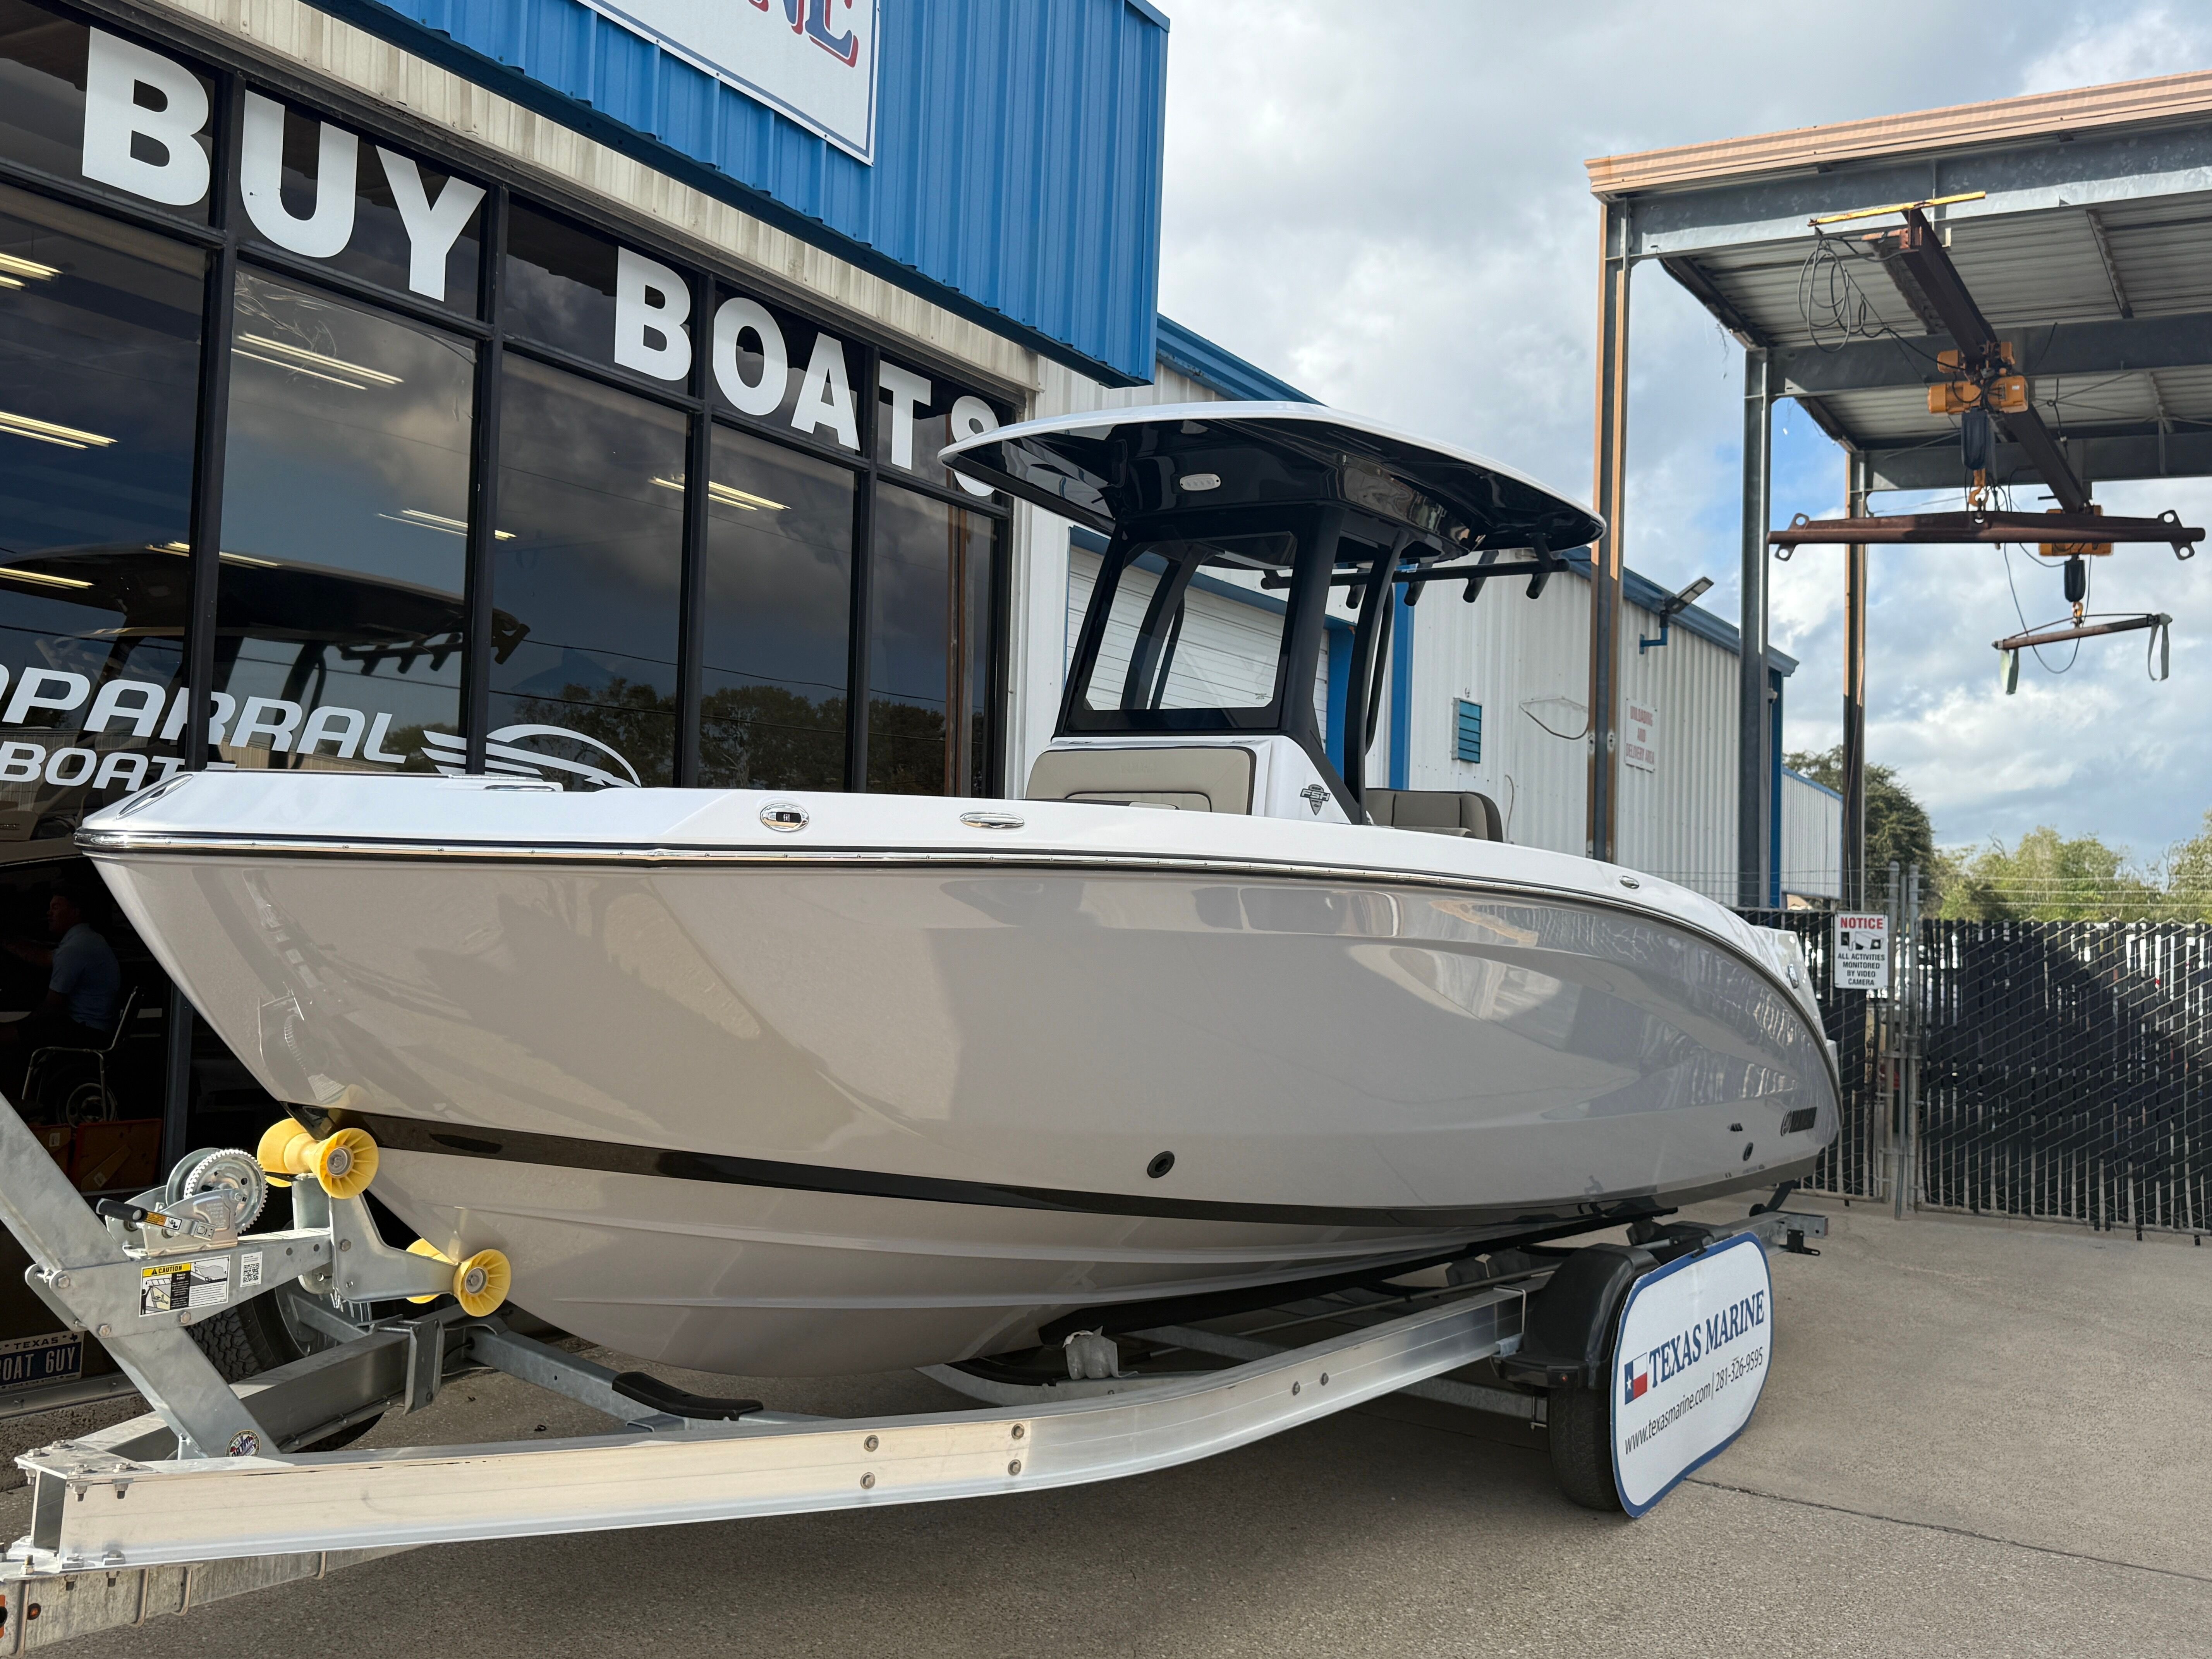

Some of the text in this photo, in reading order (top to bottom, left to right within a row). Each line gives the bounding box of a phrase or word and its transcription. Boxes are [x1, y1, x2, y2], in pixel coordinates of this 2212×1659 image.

[82, 26, 1000, 497] BUY BOATS
[0, 663, 407, 764] PARRAL
[0, 741, 237, 792] BOAT
[1301, 789, 1330, 801] FSH
[1840, 917, 1883, 929] NOTICE
[1851, 953, 1885, 961] ACTIVITIES
[158, 1265, 182, 1274] CAUTION
[14, 1336, 58, 1350] TEXAS
[1649, 1289, 1764, 1388] TEXAS MARINE
[0, 1346, 75, 1381] OAT GUY
[1625, 1382, 1710, 1455] www.texasmarine.com
[1715, 1346, 1763, 1392] 281-326-9595
